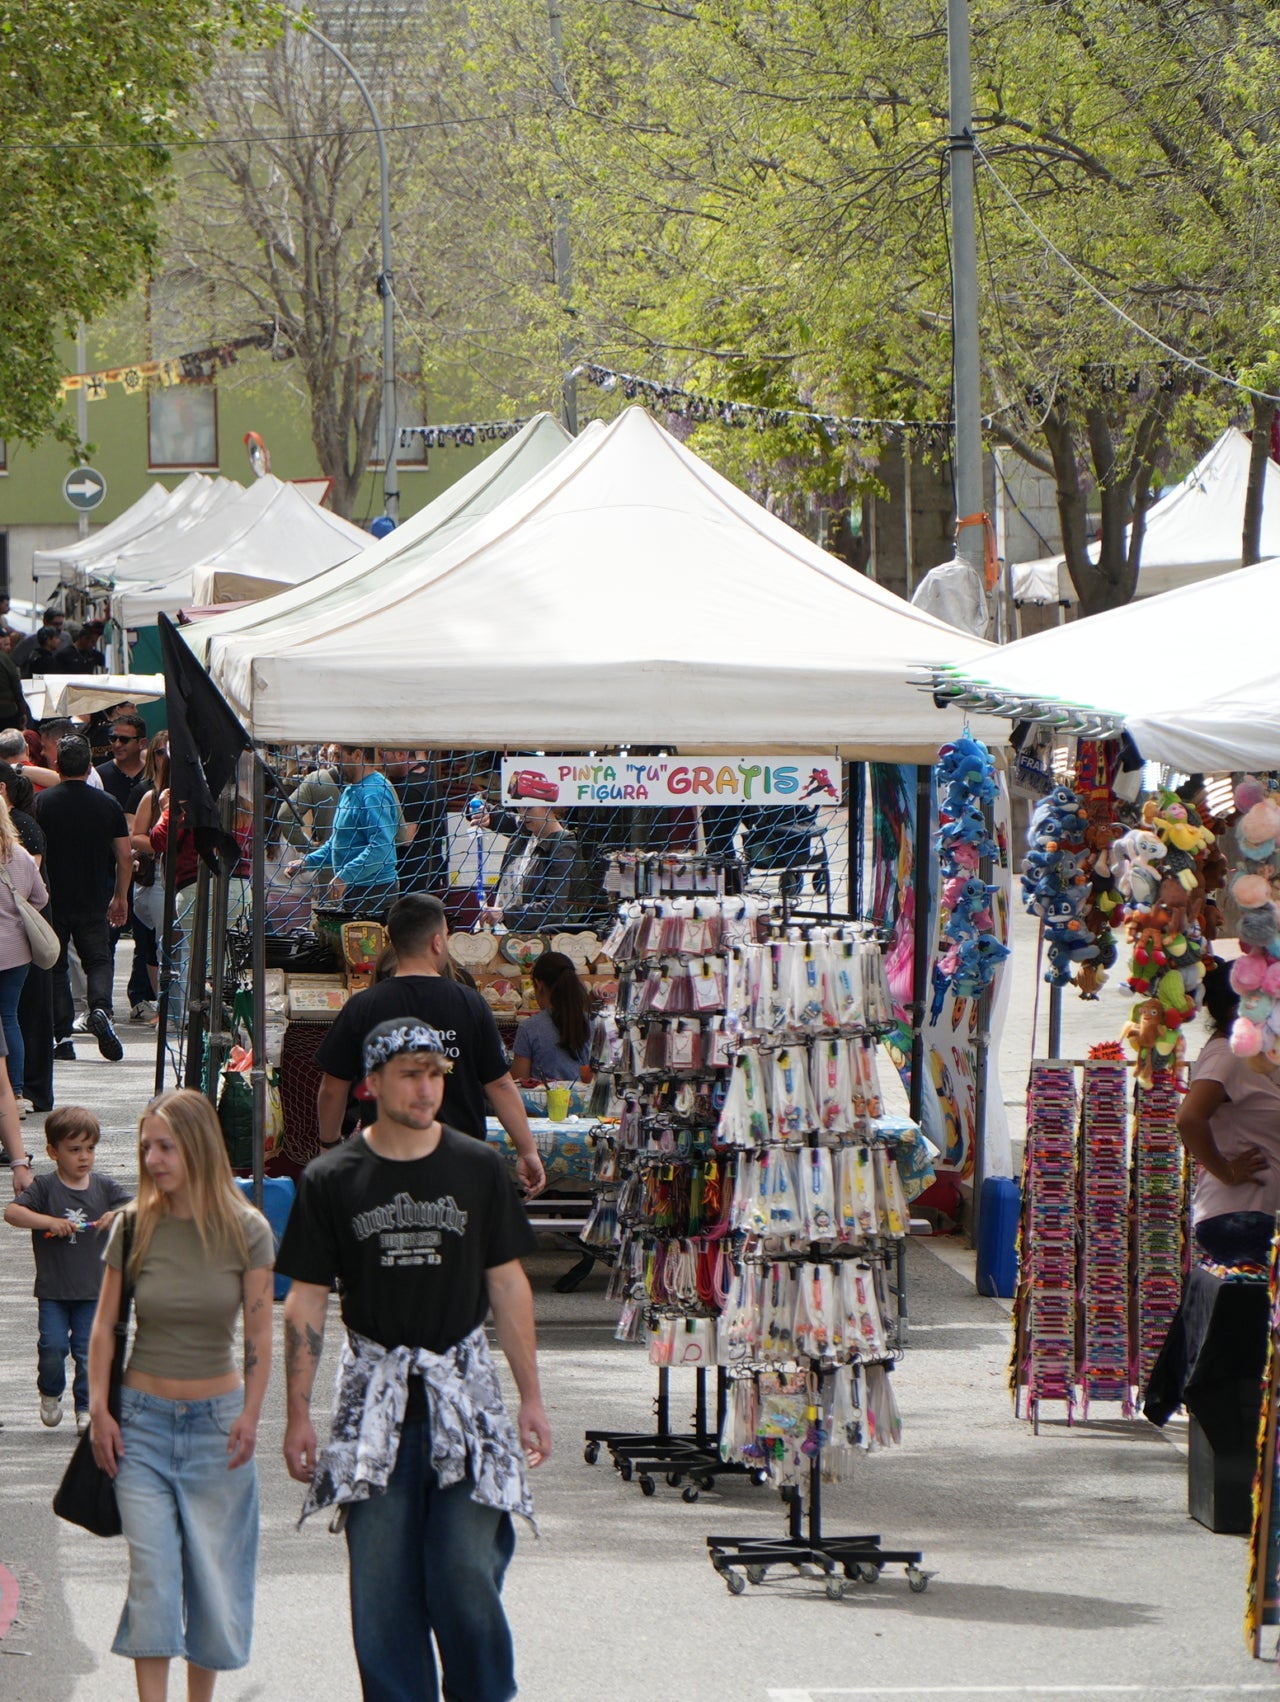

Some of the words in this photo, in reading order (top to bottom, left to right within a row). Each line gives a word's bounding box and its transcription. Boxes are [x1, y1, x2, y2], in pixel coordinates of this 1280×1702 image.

[558, 765, 617, 782] PINTA
[667, 764, 800, 800] GRATIS
[577, 784, 649, 801] FIGURA
